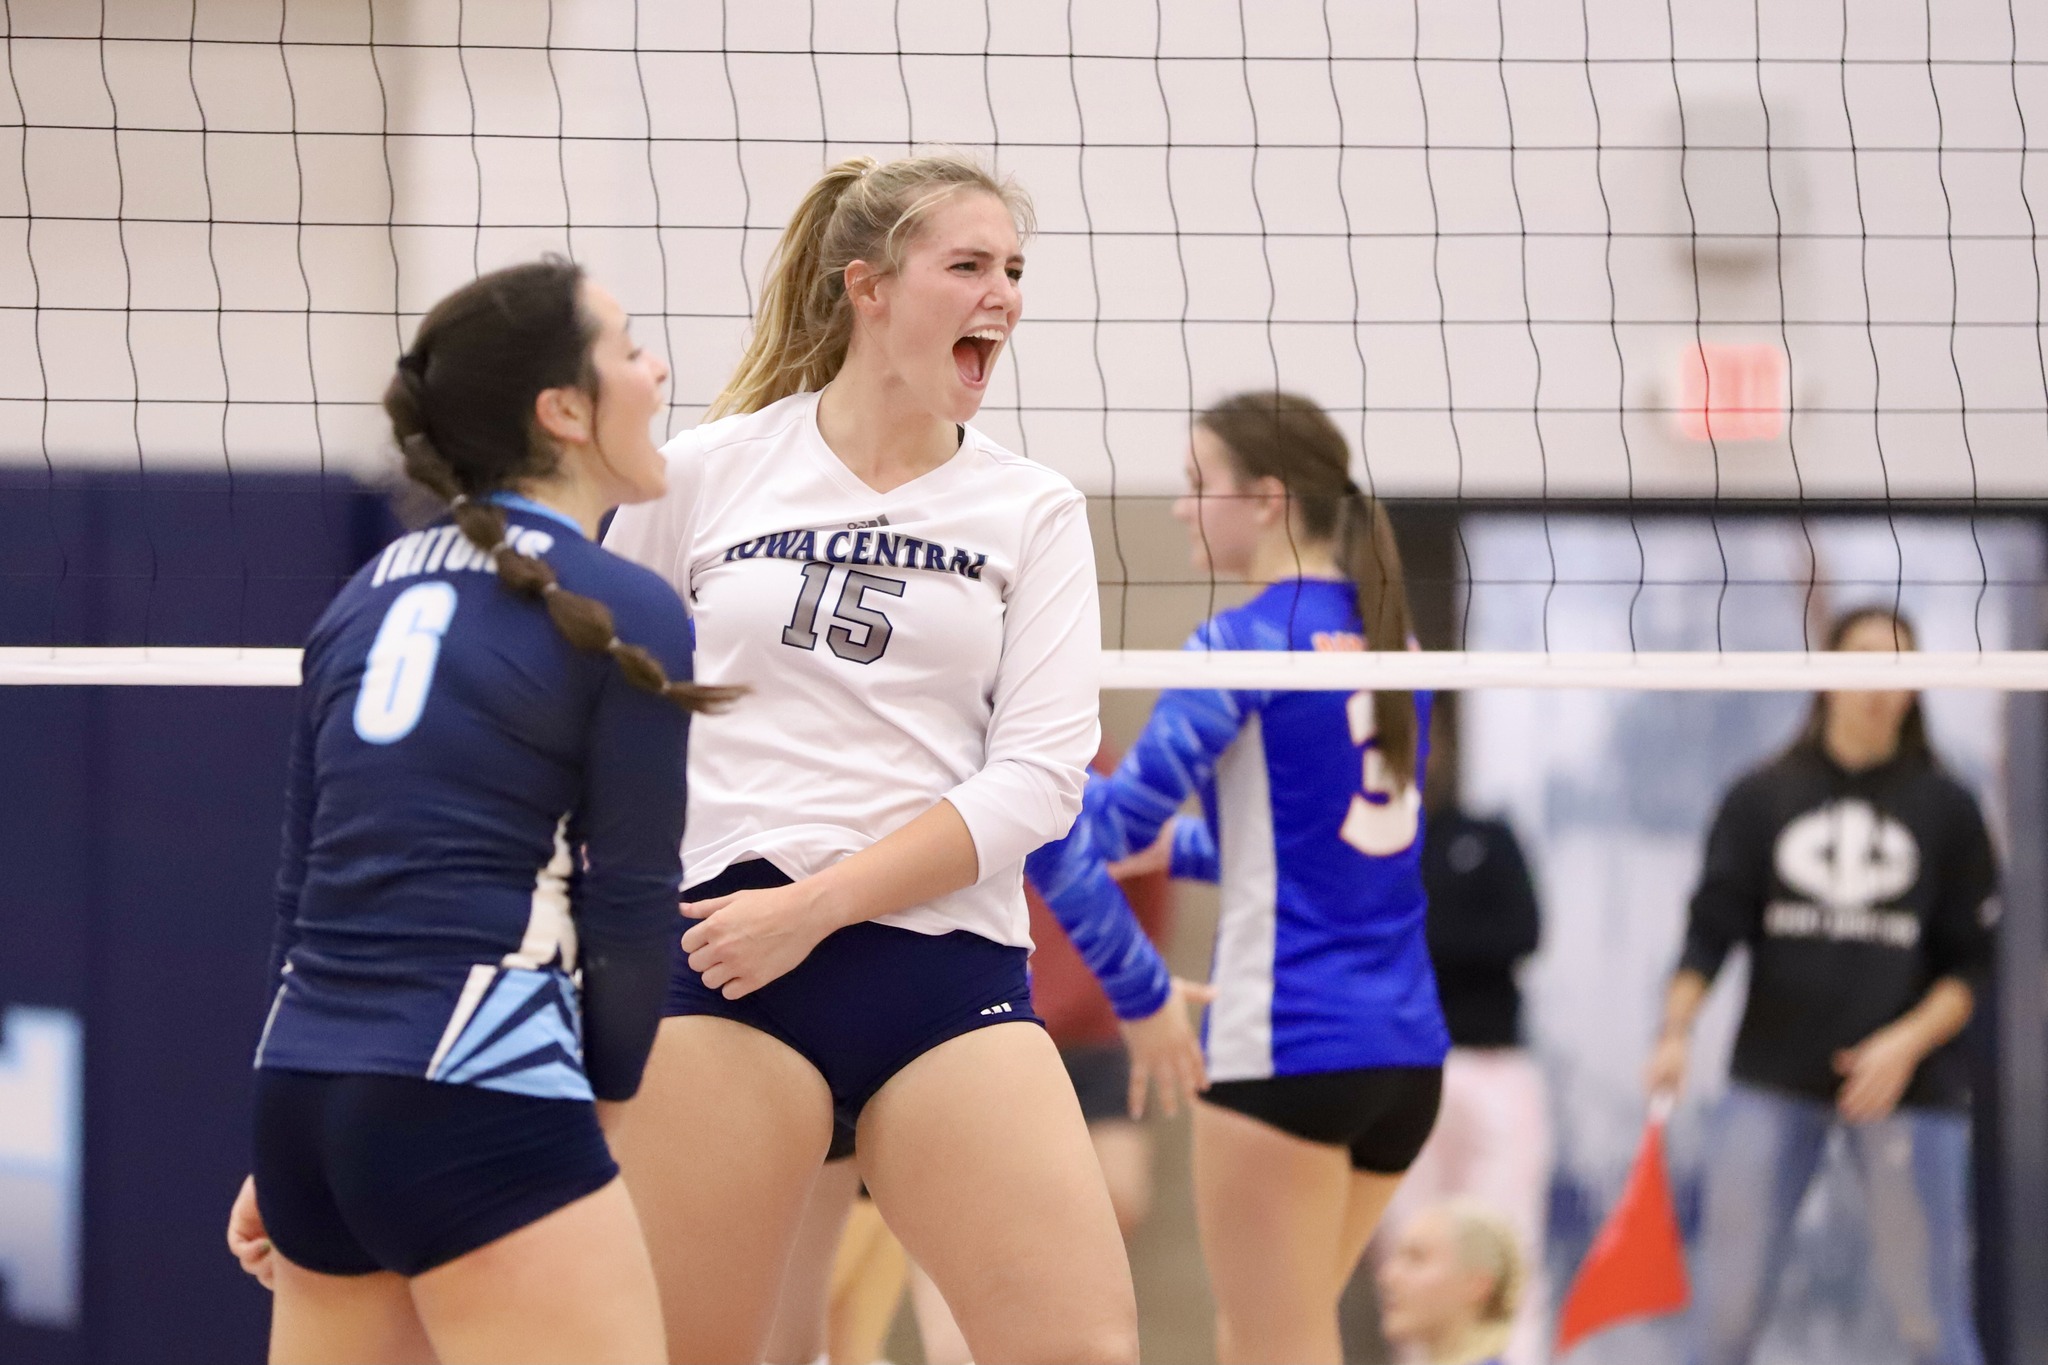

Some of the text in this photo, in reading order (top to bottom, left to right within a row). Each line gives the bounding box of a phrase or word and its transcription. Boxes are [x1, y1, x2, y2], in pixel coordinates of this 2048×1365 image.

[824, 530, 989, 582] CENTRAL
[353, 581, 458, 745] 6
[782, 561, 906, 665] 15
